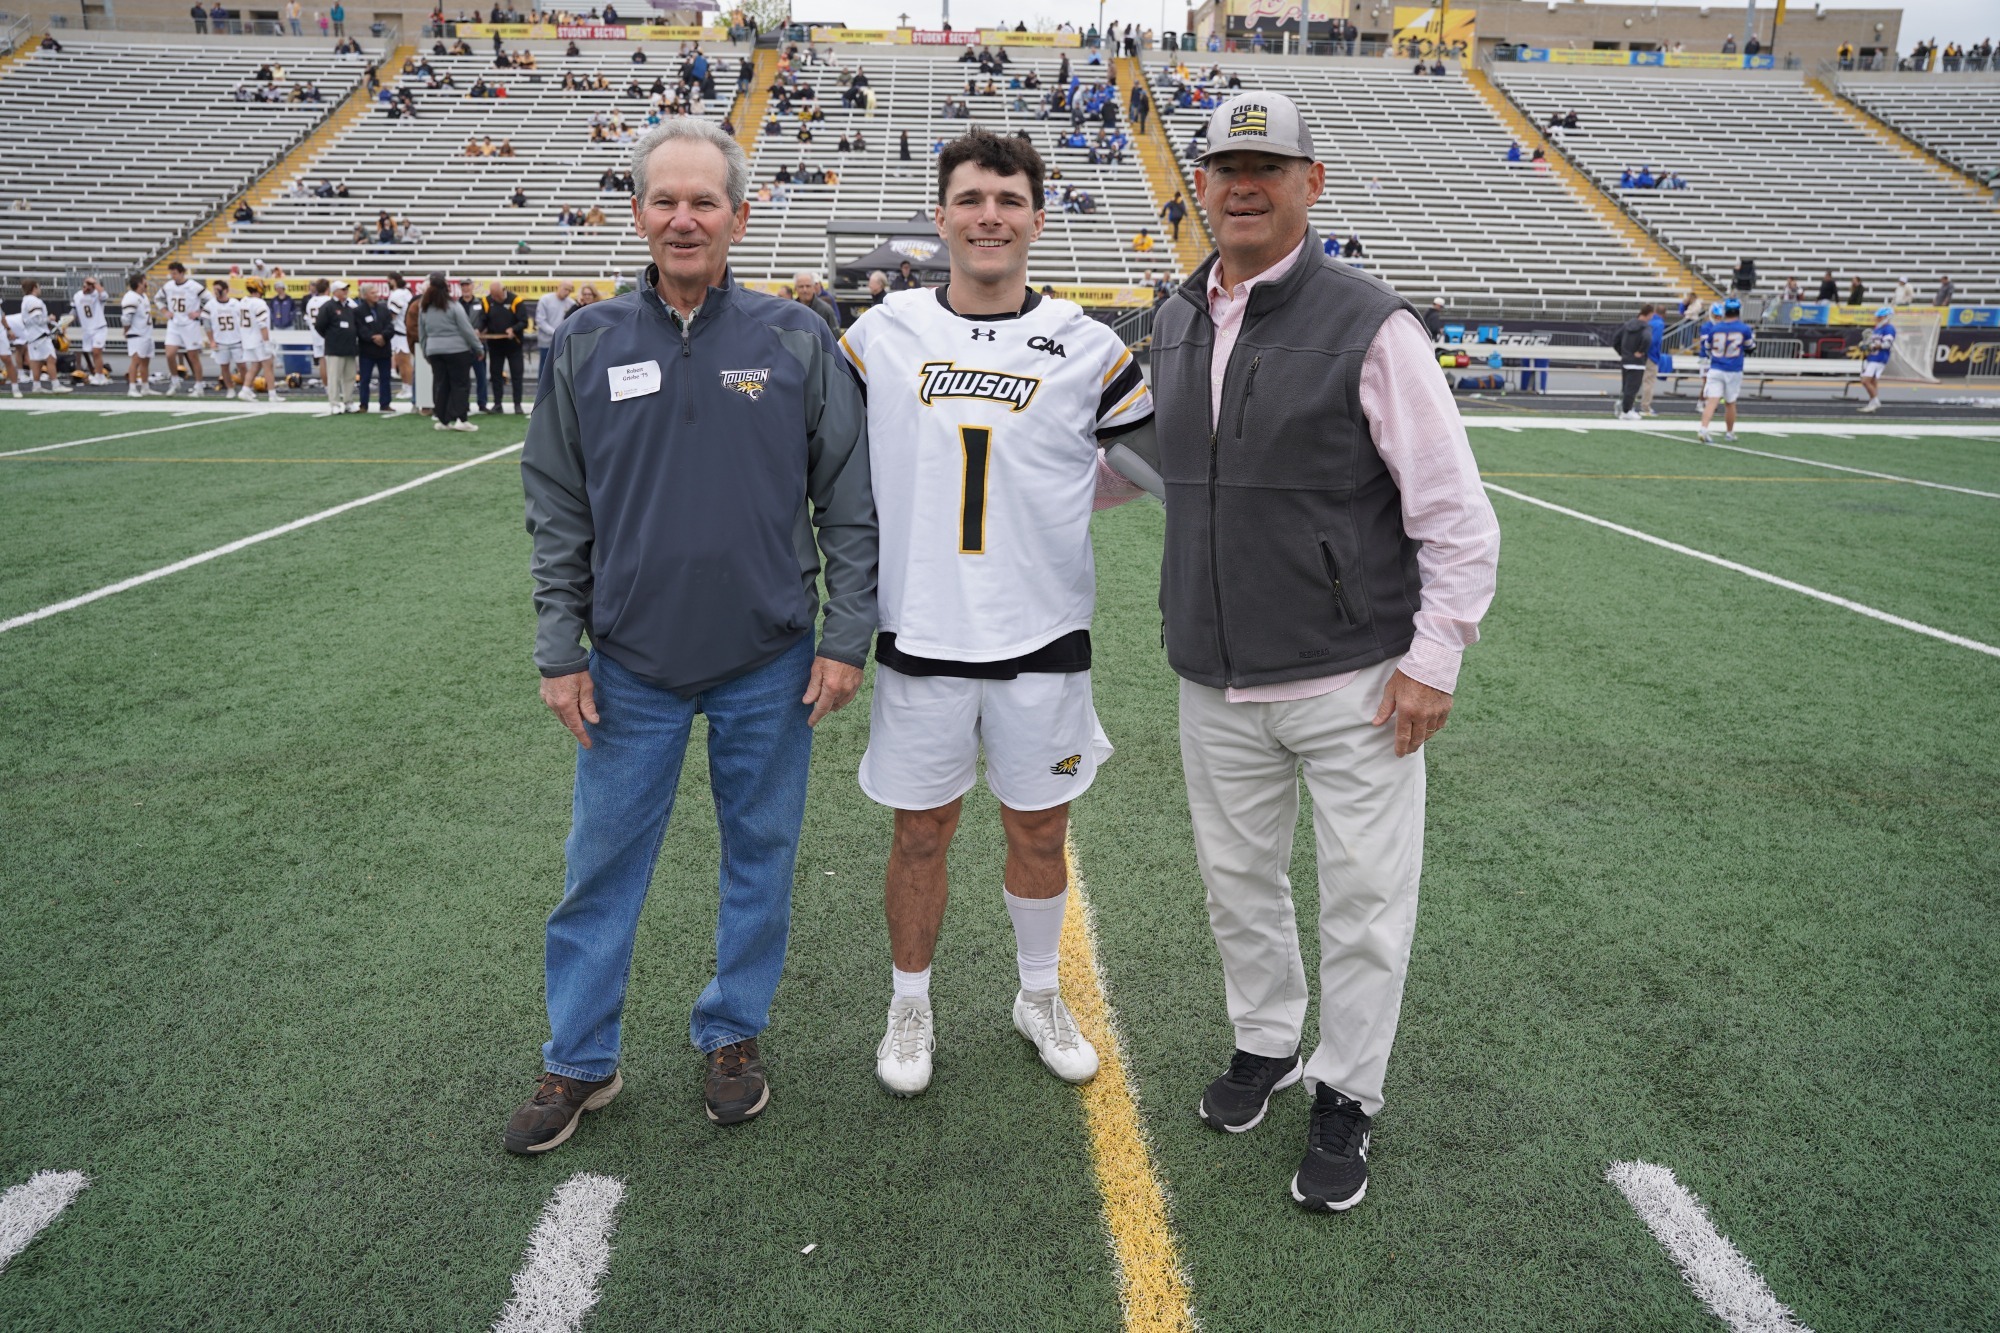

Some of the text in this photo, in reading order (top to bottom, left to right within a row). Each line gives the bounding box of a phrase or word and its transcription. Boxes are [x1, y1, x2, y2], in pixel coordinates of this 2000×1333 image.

[558, 27, 626, 39] STUDENT SECTION
[912, 32, 981, 44] STUDENT SECTION
[1233, 104, 1268, 114] TIGER
[1228, 130, 1267, 138] LACROSSE
[889, 240, 940, 252] TOWSON
[1070, 291, 1077, 299] IN
[1079, 291, 1114, 300] MARYLAND
[218, 316, 234, 331] 55
[1027, 336, 1067, 358] CAA
[1711, 331, 1744, 358] 32
[719, 368, 770, 388] TOWSON
[919, 361, 1042, 412] TOWSON
[958, 424, 992, 555] 1
